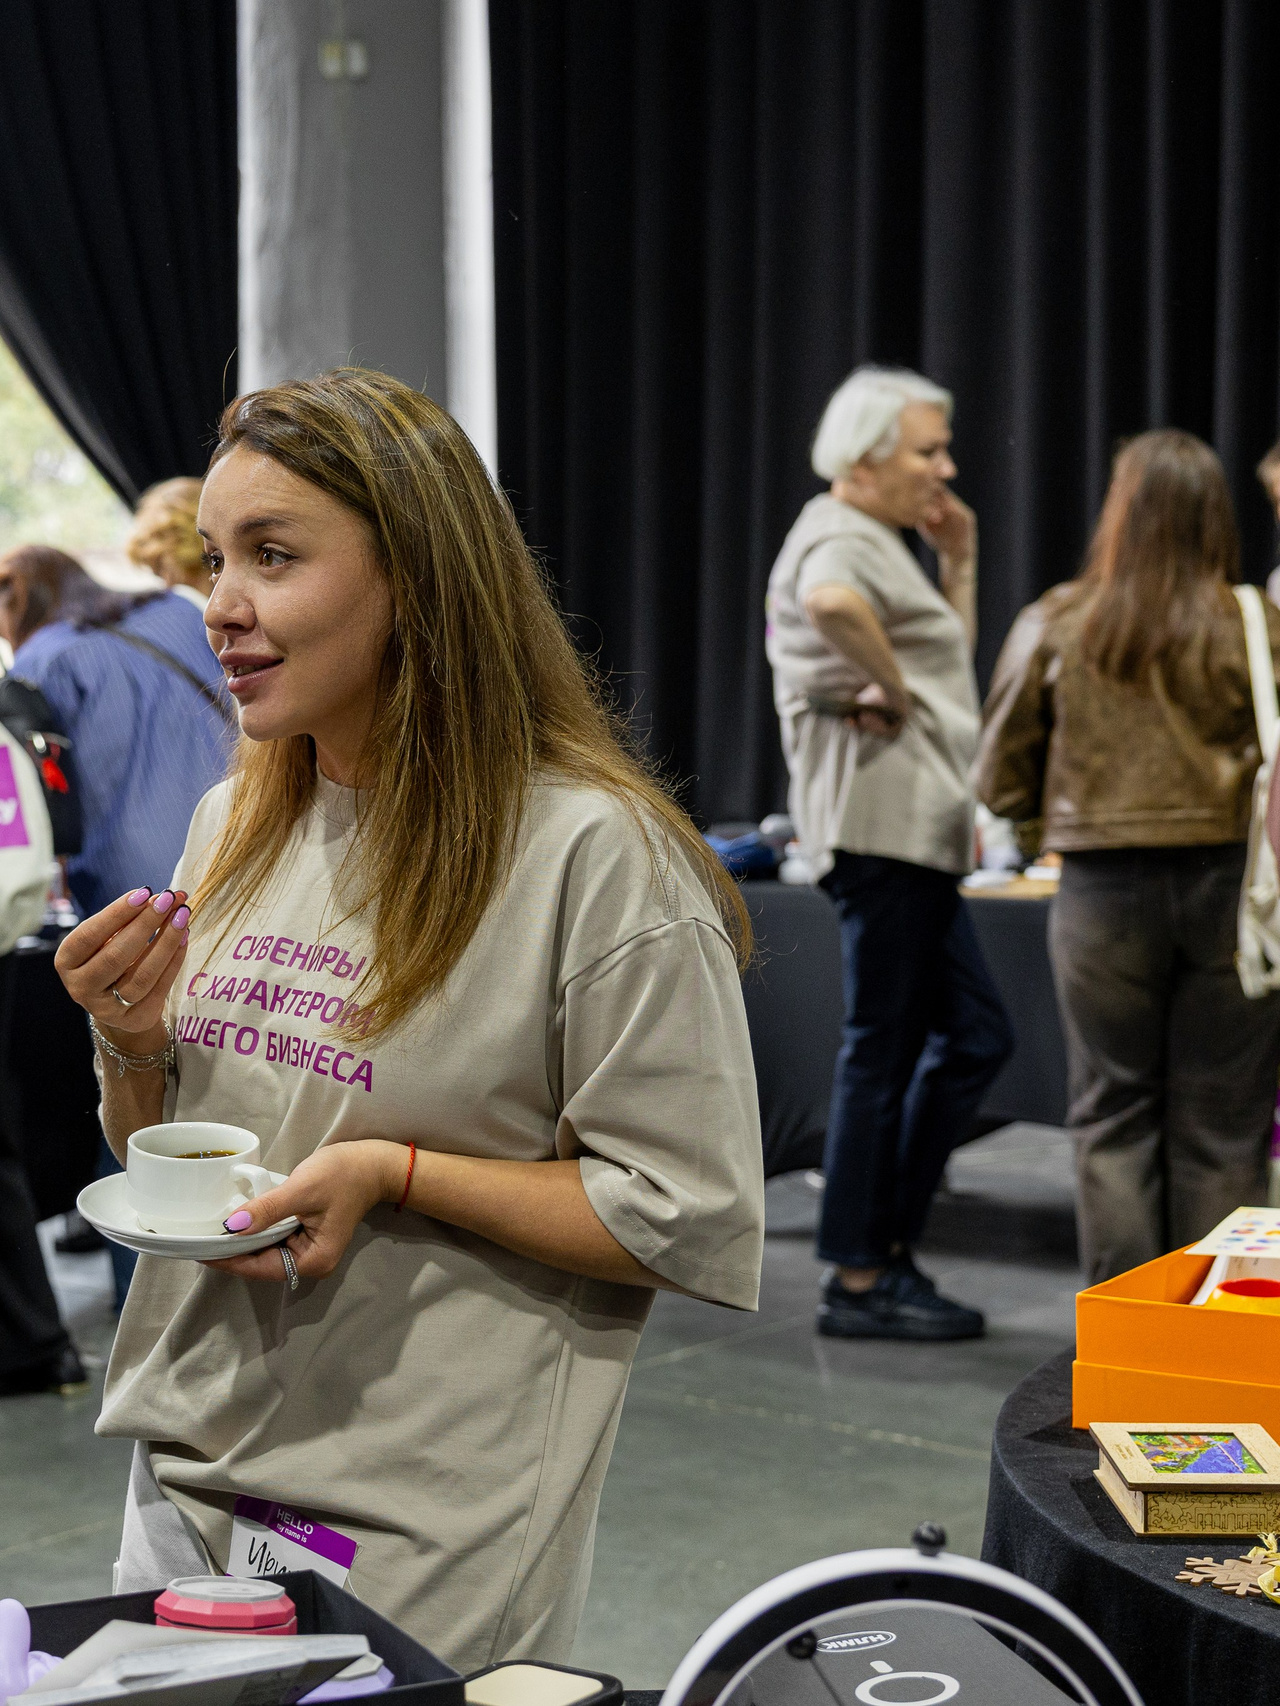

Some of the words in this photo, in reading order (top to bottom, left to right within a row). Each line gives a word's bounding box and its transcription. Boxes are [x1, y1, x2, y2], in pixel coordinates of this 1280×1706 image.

[232, 935, 368, 982] СУВЕНИРЫ
[187, 973, 207, 997] С
[175, 1014, 260, 1057] АШЕГО
[265, 1031, 375, 1094] БИЗНЕСА
[276, 1508, 314, 1535] HELLO
[285, 1527, 301, 1541] name
[300, 1535, 308, 1544] is
[822, 1634, 887, 1650] НЛМК
